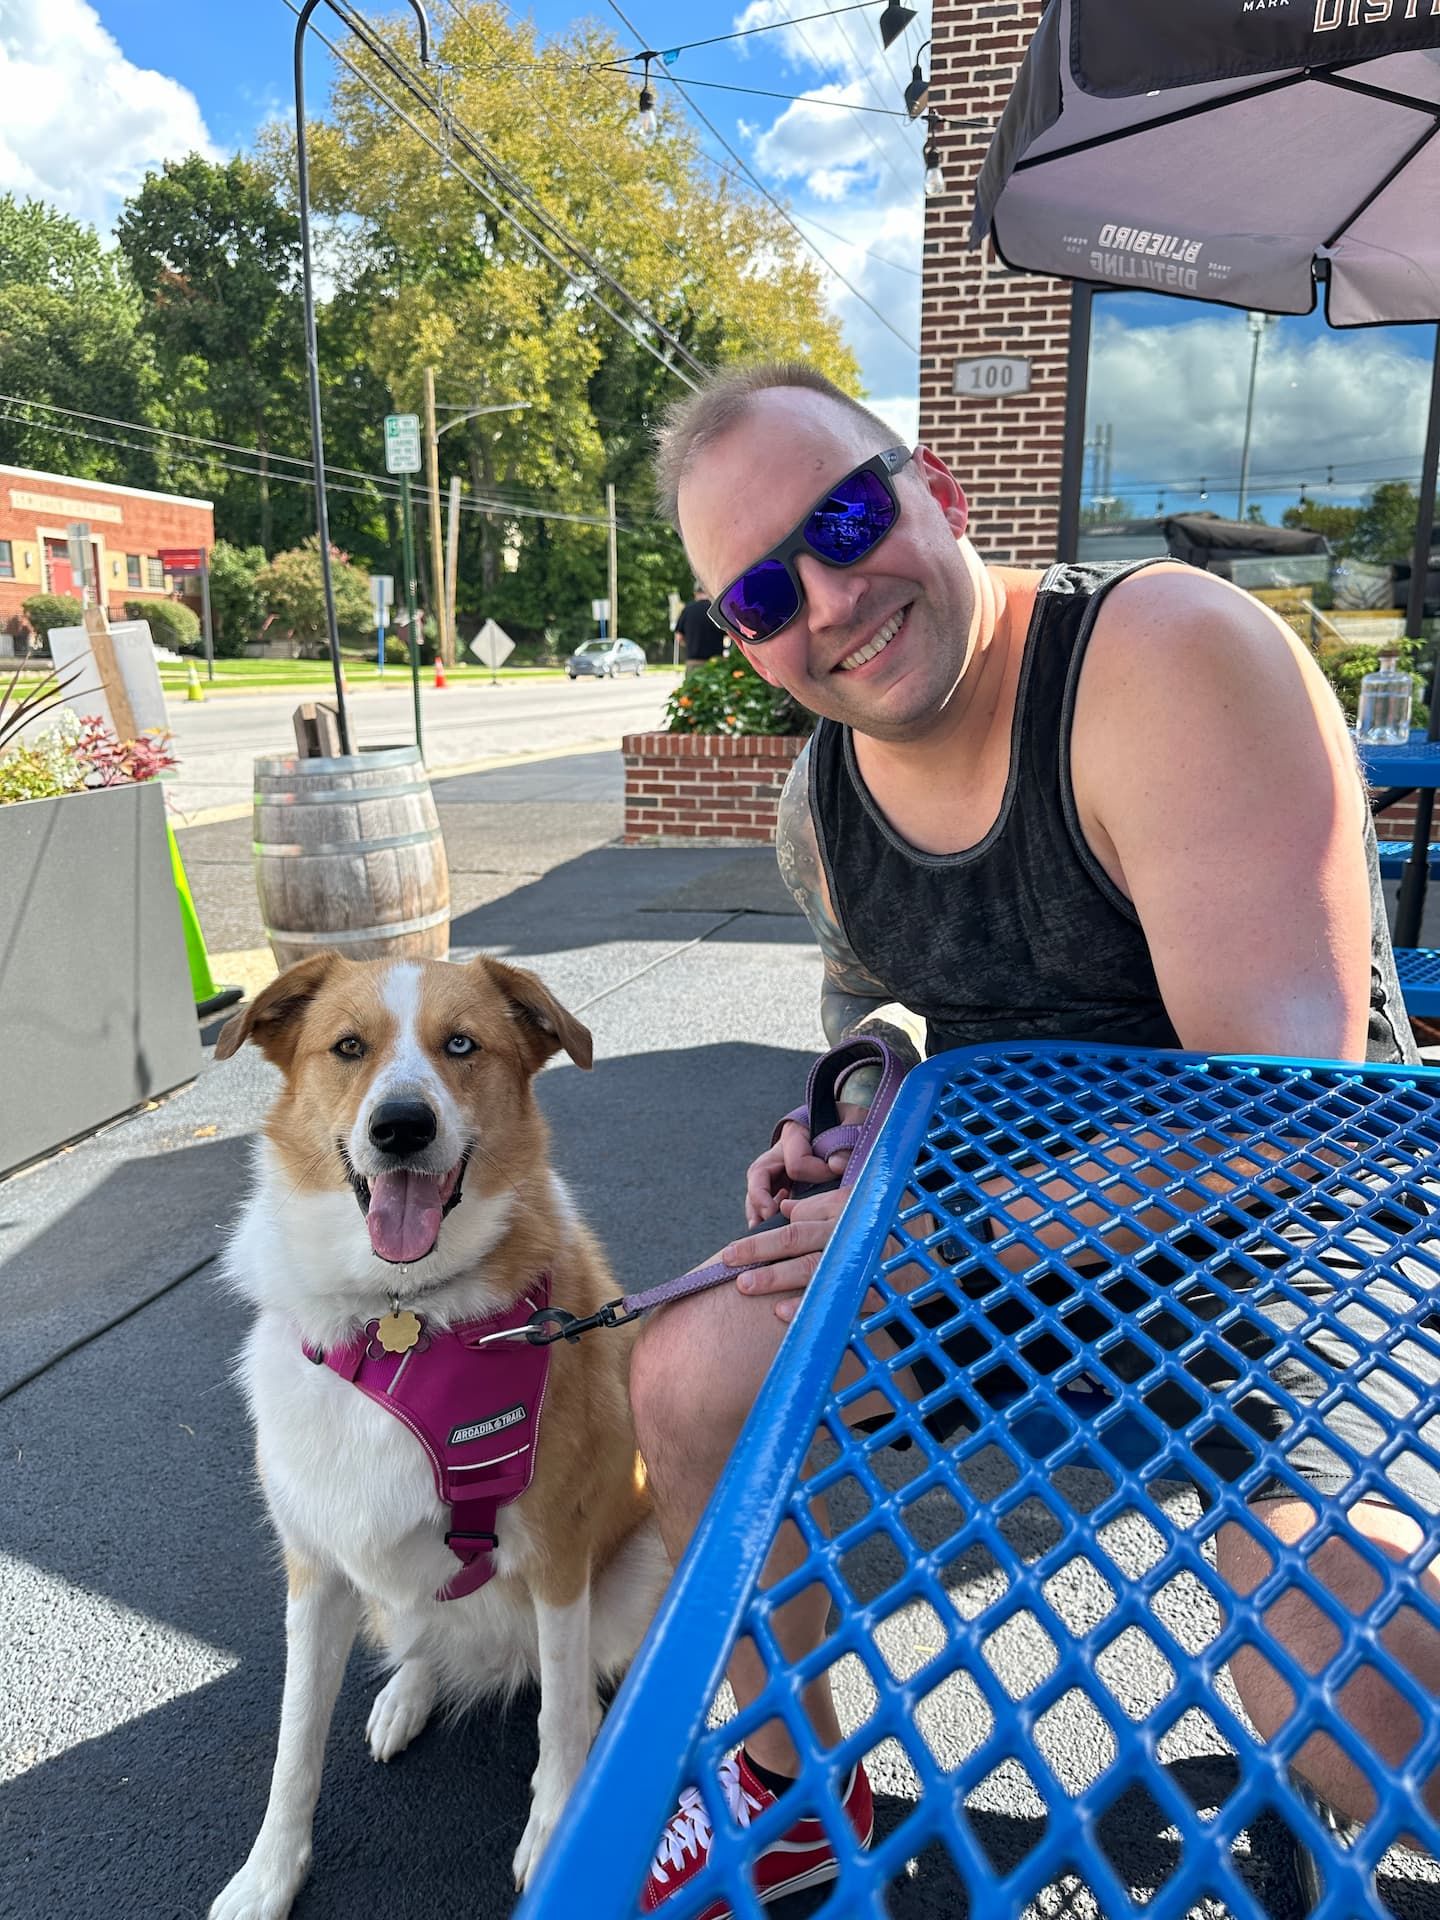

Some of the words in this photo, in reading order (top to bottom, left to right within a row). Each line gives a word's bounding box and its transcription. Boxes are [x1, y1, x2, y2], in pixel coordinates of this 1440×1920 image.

[970, 365, 1013, 389] 100
[455, 1422, 495, 1441] ARCADIA
[502, 1409, 523, 1425] TRAIL
